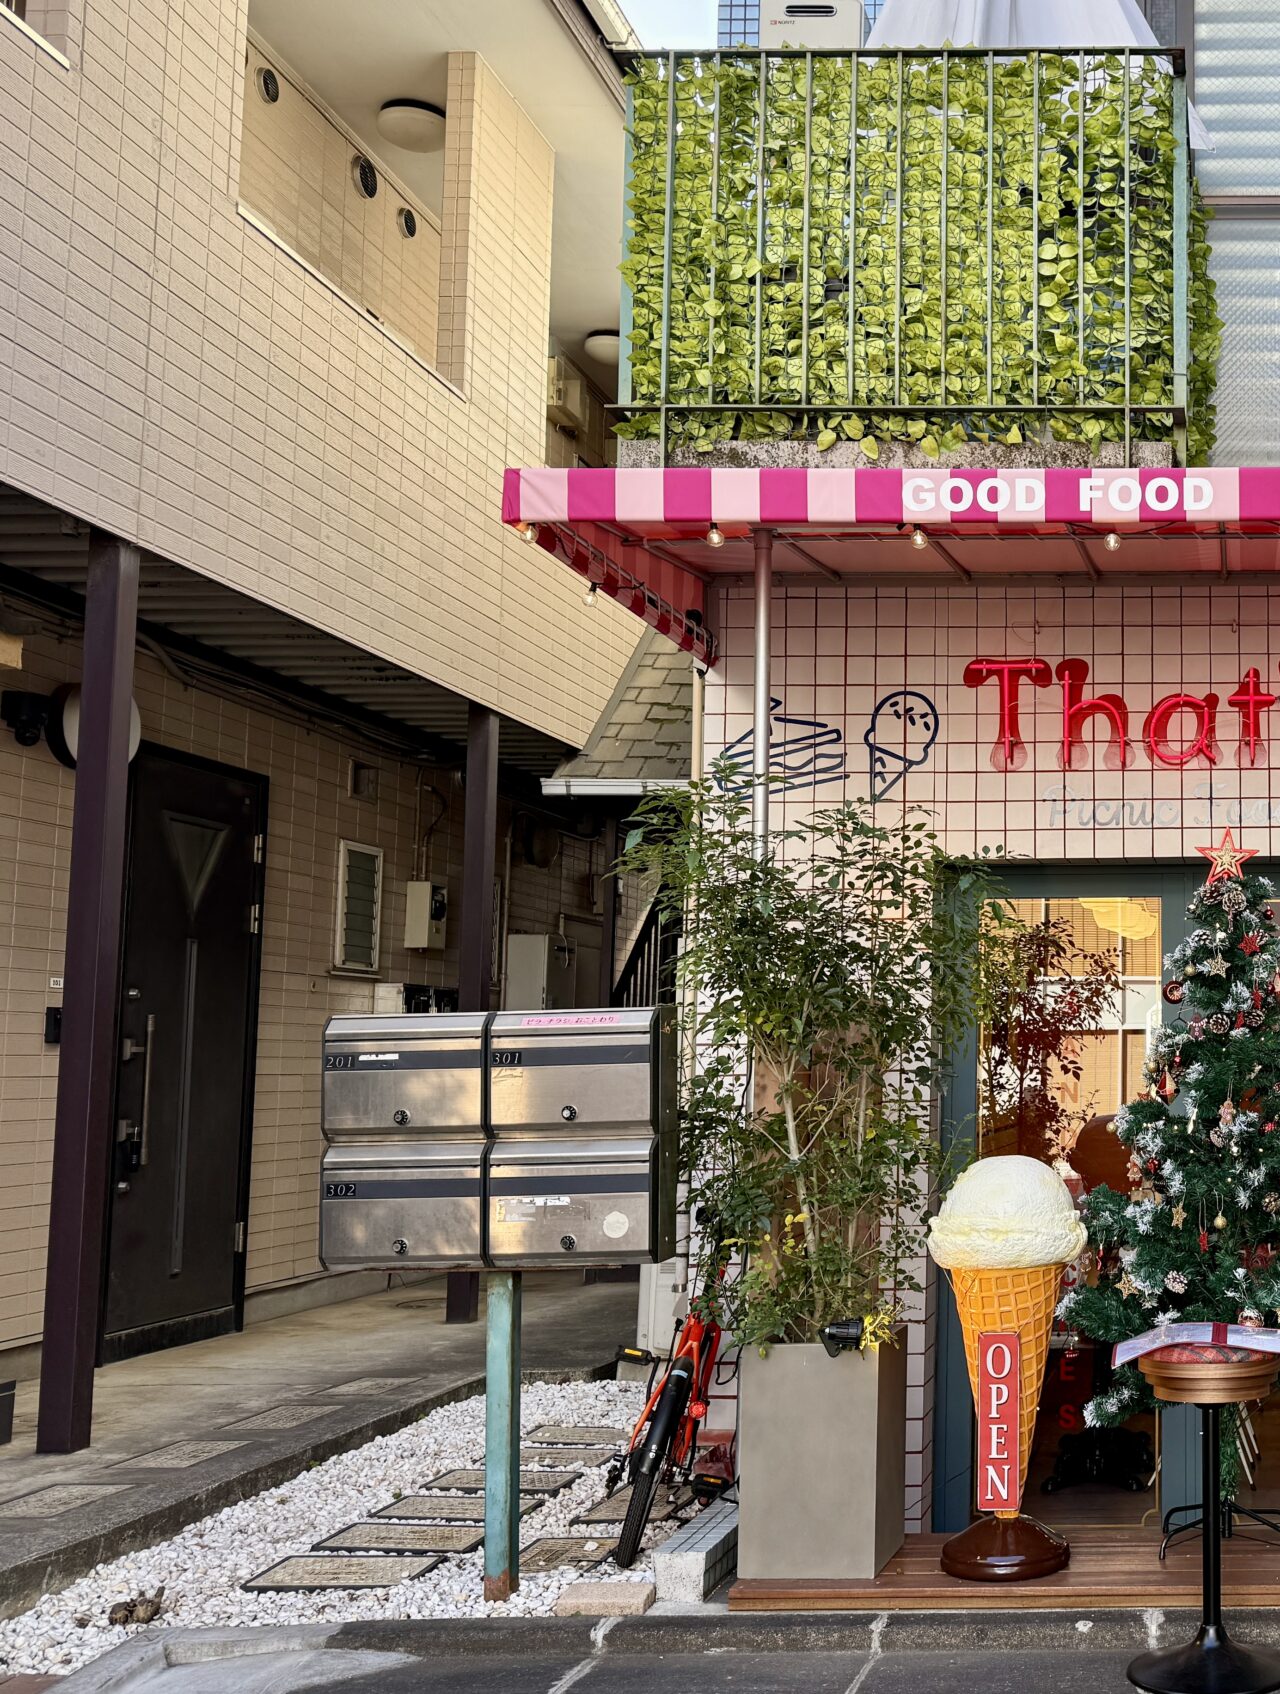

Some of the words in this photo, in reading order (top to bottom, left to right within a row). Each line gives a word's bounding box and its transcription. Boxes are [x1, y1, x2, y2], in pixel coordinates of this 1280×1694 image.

[902, 477, 1046, 513] GOOD
[1079, 477, 1214, 512] FOOD
[1041, 783, 1180, 828] Picnic
[326, 1056, 352, 1068] 201
[492, 1052, 521, 1065] 301
[327, 1184, 356, 1197] 302
[985, 1342, 1012, 1501] OPEN
